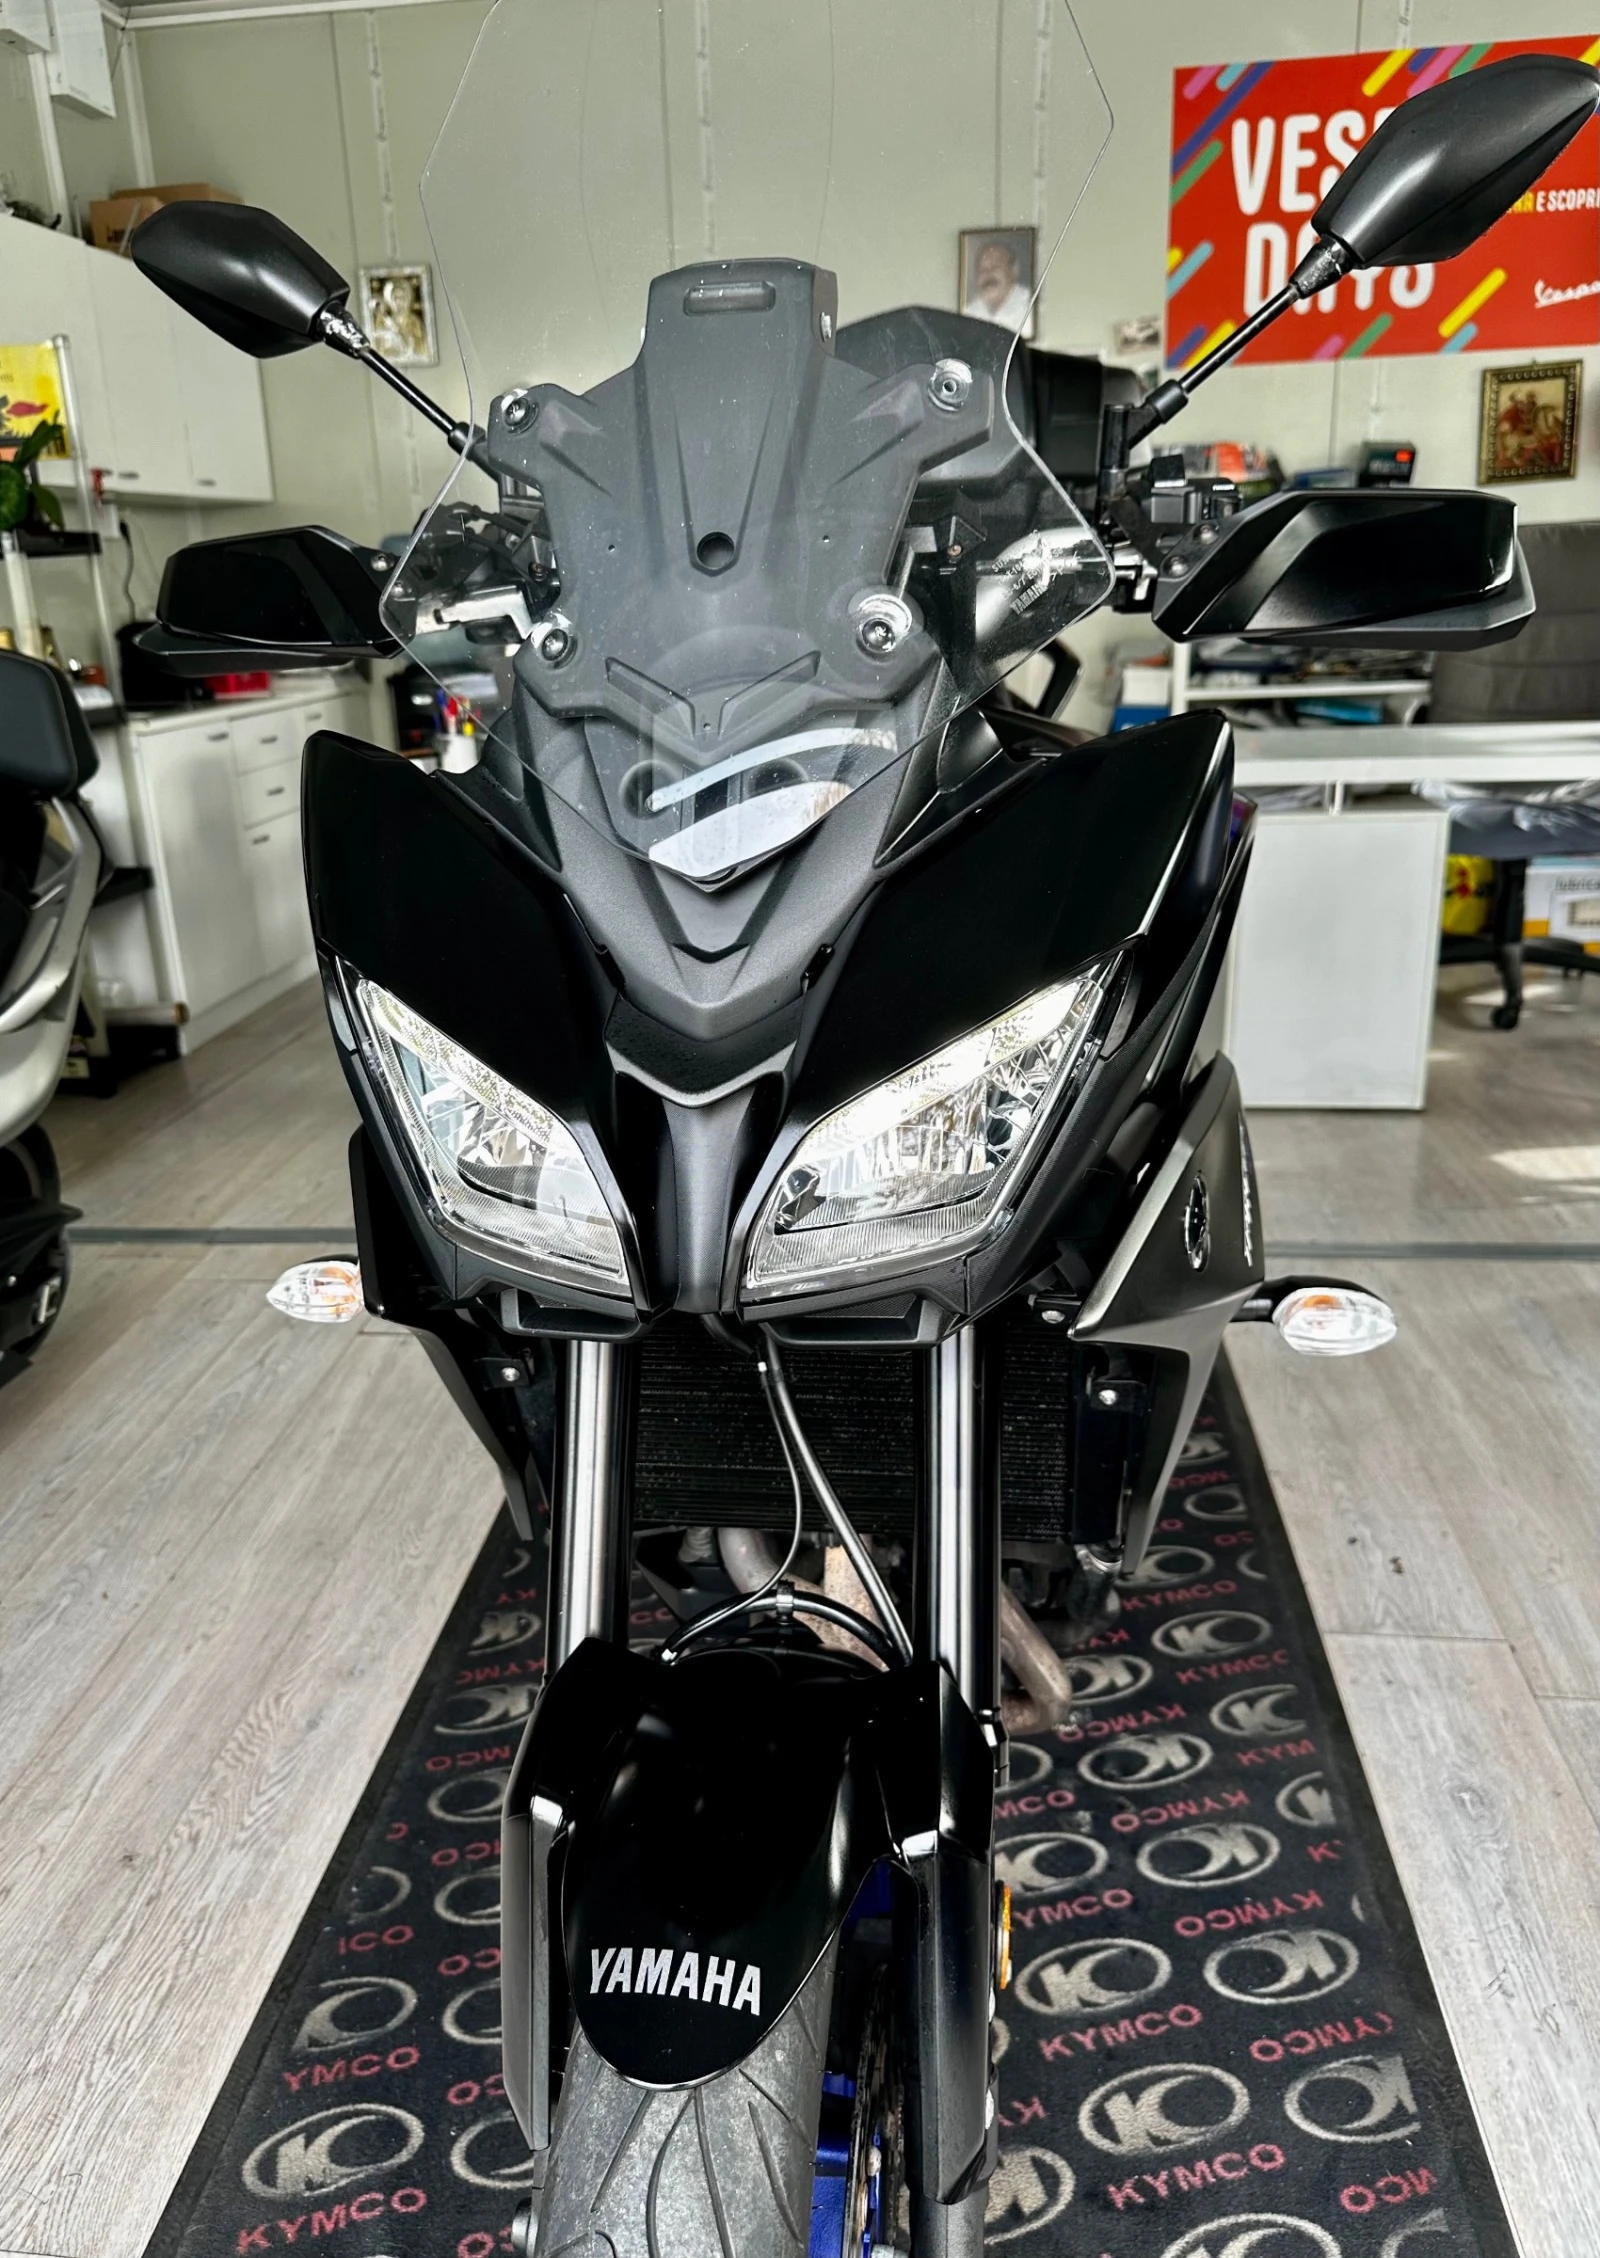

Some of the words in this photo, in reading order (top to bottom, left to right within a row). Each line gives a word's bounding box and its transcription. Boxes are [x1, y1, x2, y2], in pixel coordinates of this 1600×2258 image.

[1231, 107, 1397, 216] VES
[1123, 1580, 1238, 1611] KYMCO
[1111, 1788, 1250, 1833] KYMCO
[1175, 1889, 1323, 1936] KYMCO
[590, 1947, 761, 2016] YAMAHA
[1040, 2004, 1202, 2060] KYMCO
[1107, 2144, 1285, 2210] KYMCO
[237, 2187, 427, 2255] KYMCO
